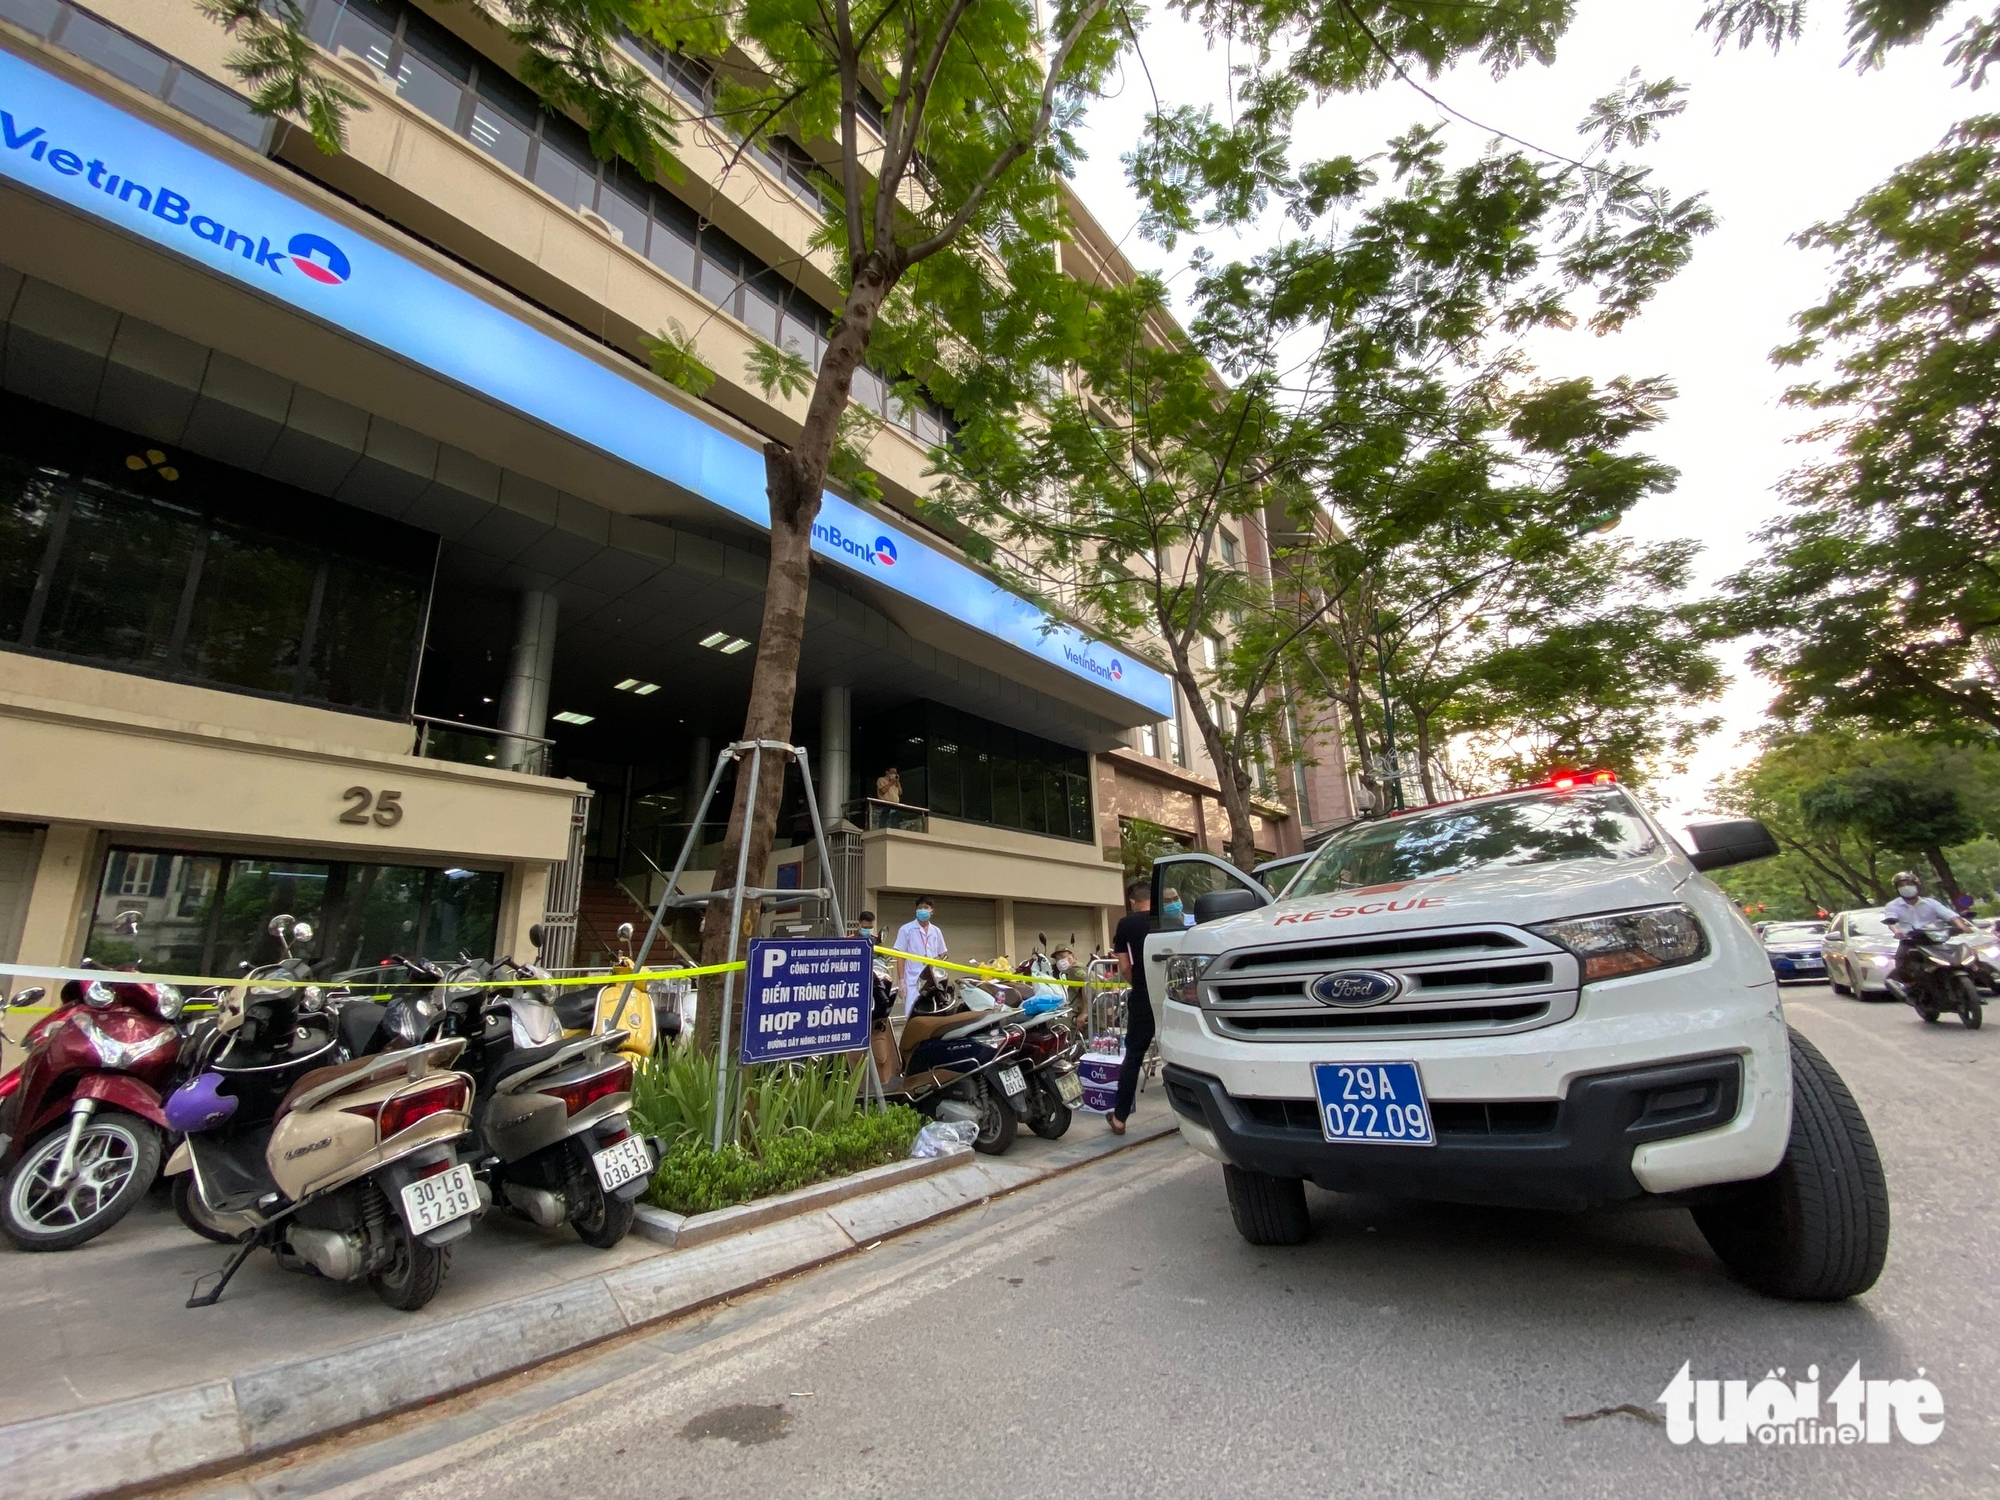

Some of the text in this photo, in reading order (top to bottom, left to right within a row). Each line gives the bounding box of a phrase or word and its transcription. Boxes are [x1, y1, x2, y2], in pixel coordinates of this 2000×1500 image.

[0, 110, 287, 275] VietinBank
[811, 523, 876, 566] inBank
[1063, 644, 1113, 681] VietinBank
[339, 786, 403, 827] 25
[1274, 897, 1446, 926] RESCUE
[762, 949, 787, 978] P
[790, 961, 809, 975] CÔNG
[811, 963, 819, 973] TY
[762, 980, 860, 1004] ĐIỂM TRÔNG GIỮ XE
[1331, 978, 1373, 998] Ford
[759, 1003, 859, 1035] HỢP ĐỒNG
[1338, 1068, 1396, 1100] 29A
[1326, 1103, 1426, 1138] 022.09
[601, 1139, 640, 1169] 29-E1
[413, 1171, 464, 1205] 30-L6
[603, 1155, 649, 1189] 038.33
[419, 1192, 470, 1226] 5239
